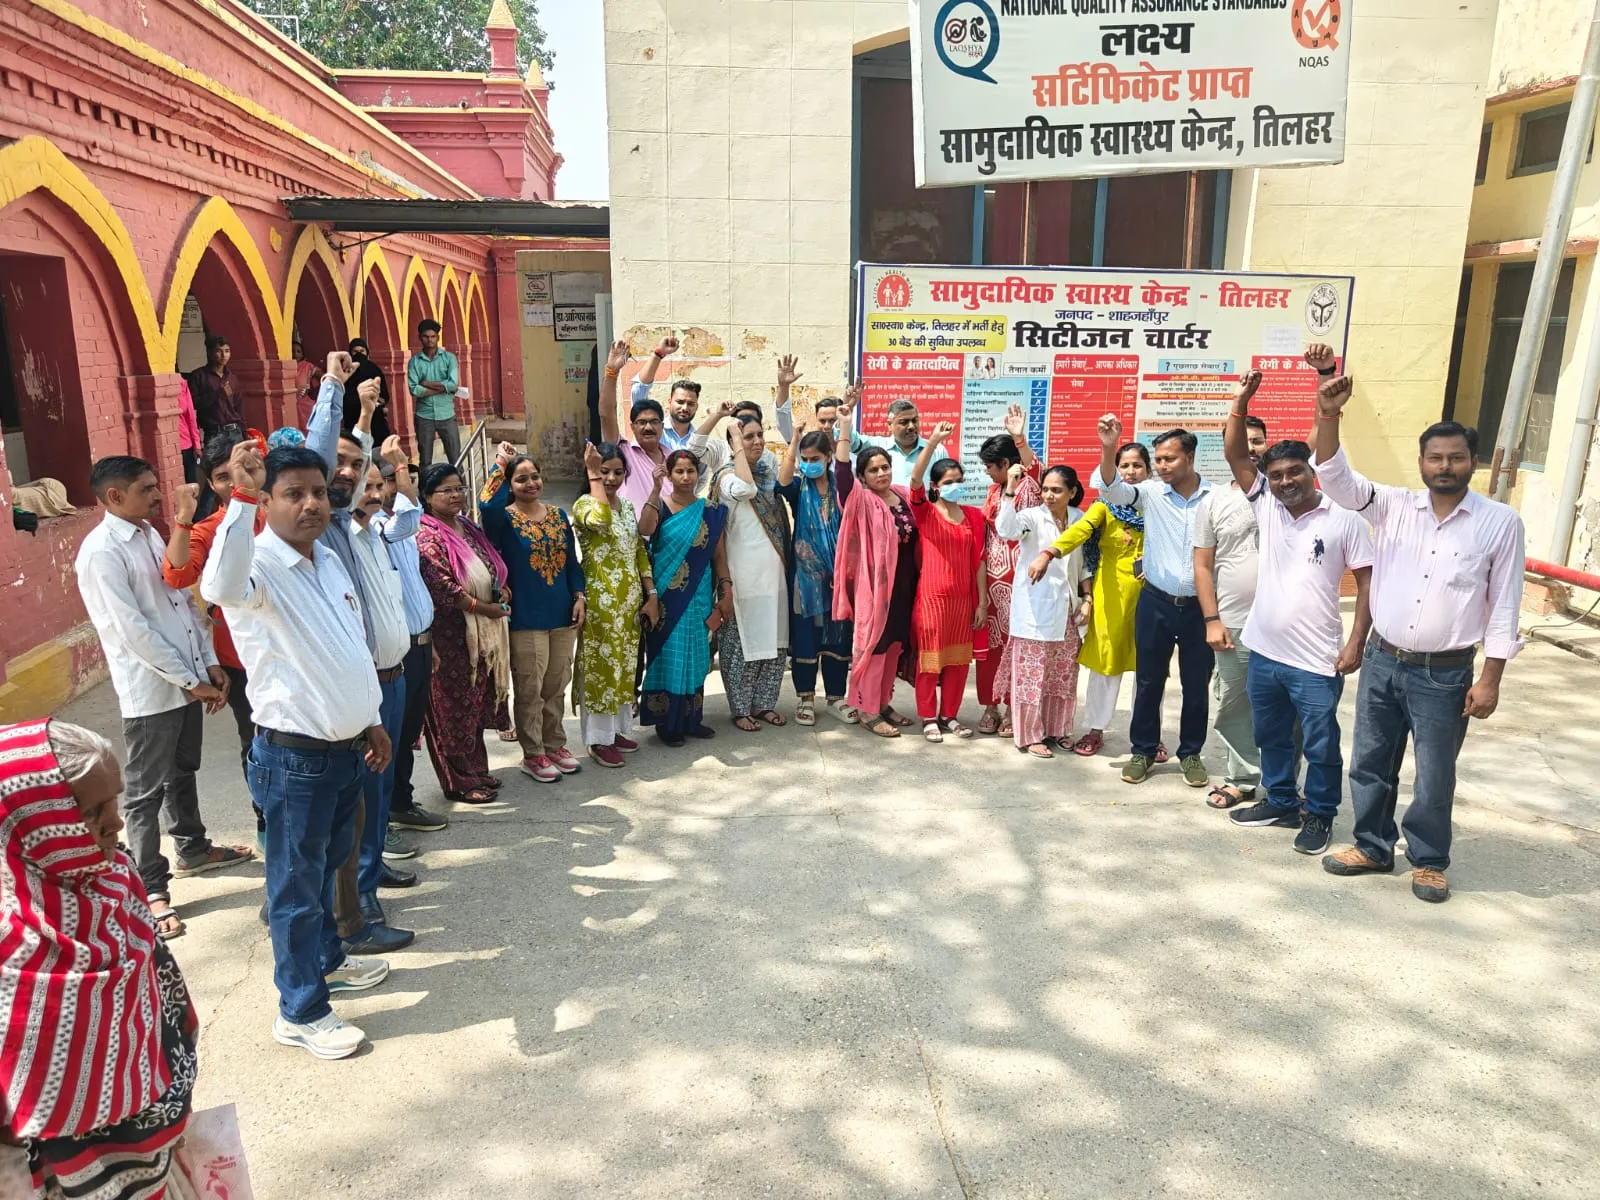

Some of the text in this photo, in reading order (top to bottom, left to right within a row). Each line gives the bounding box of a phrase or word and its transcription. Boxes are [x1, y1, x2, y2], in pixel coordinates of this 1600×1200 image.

[1001, 0, 1068, 16] NATIONAL
[1071, 0, 1127, 17] QUALITY
[1131, 0, 1208, 12] ASSURANCE
[1099, 22, 1195, 57] लक्ष्य
[949, 44, 983, 53] LAQSHYA
[1299, 56, 1329, 68] NQAS
[1031, 61, 1254, 108] सर्टिफिकेट प्राप्त
[940, 104, 1335, 175] सामुदायिक स्वास्थ्य केन्द्र, तिलहर
[929, 276, 1057, 311] सामुदायिक
[1140, 279, 1190, 307] केन्द्र
[1219, 281, 1291, 308] तिलहर
[1055, 309, 1094, 321] जनपद
[1108, 308, 1170, 325] शाहजहाँपुर
[932, 319, 960, 331] तिलहर
[962, 320, 971, 331] में
[972, 319, 989, 332] भर्ती
[991, 321, 1005, 335] हेतु
[1013, 321, 1212, 349] सिटीजन चार्टर
[888, 335, 986, 351] 30 बेड की सुविधा उपलब्ध
[867, 355, 960, 371] रोगी के उत्तरदायित्व
[1259, 358, 1279, 370] रोगी
[1282, 358, 1293, 370] के
